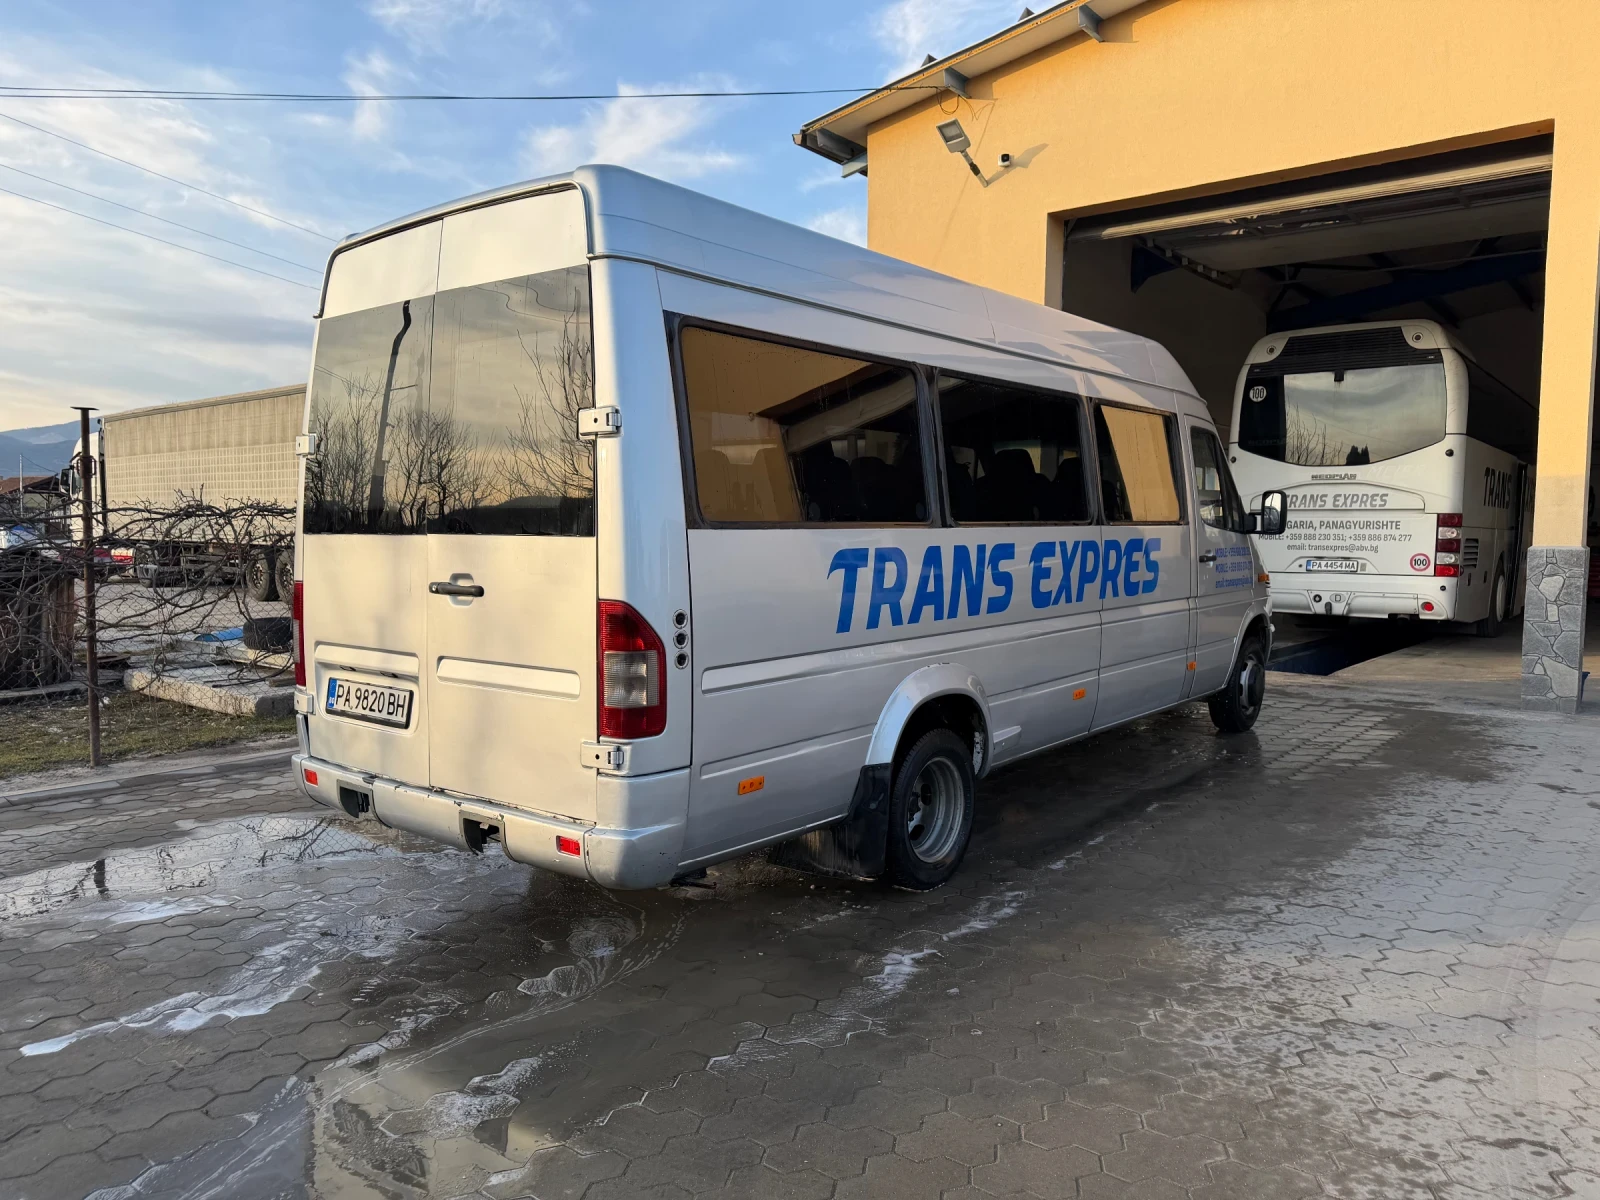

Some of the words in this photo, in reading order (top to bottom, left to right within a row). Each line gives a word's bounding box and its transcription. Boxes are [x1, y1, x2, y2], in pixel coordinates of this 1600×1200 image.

[1483, 467, 1512, 509] TRANS
[1286, 493, 1328, 508] RANS
[1332, 493, 1389, 508] EXPRES
[1286, 520, 1317, 531] GARIA,
[1319, 520, 1401, 530] PANAGYURISHTE
[1286, 533, 1302, 541] +359
[1317, 533, 1331, 541] 230
[1348, 534, 1367, 542] +359
[1383, 534, 1397, 542] 874
[1398, 534, 1413, 542] 277
[1286, 543, 1307, 551] email:
[1308, 543, 1379, 553] transexpres@abv.bg
[1311, 561, 1323, 569] PA
[1323, 561, 1344, 569] 4454
[1344, 562, 1356, 570] MA
[1413, 558, 1428, 567] 100
[827, 542, 1015, 634] TRANS
[1028, 537, 1161, 609] EXPRES
[335, 684, 351, 707] PA
[354, 687, 386, 713] 9820
[386, 692, 407, 718] BH
